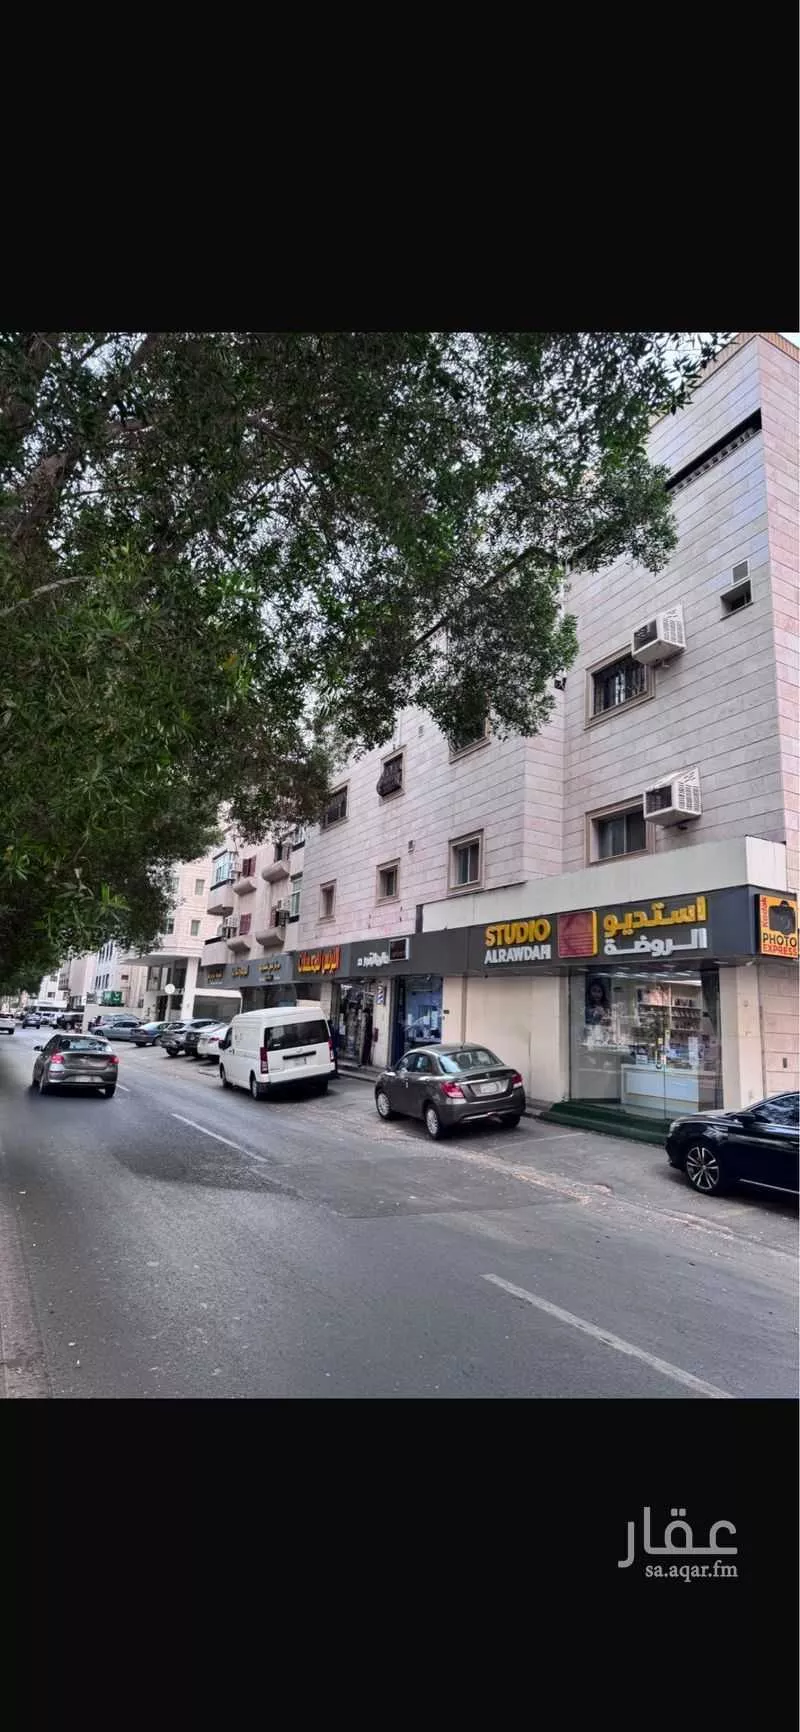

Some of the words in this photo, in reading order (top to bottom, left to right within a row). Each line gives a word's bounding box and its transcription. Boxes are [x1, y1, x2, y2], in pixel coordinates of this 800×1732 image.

[603, 896, 707, 937] استديو
[485, 918, 551, 947] STUDIO
[603, 928, 708, 957] الروضة
[763, 933, 797, 948] PHOTO
[484, 944, 551, 964] ALRAWDAH
[763, 943, 798, 955] EXPRESS
